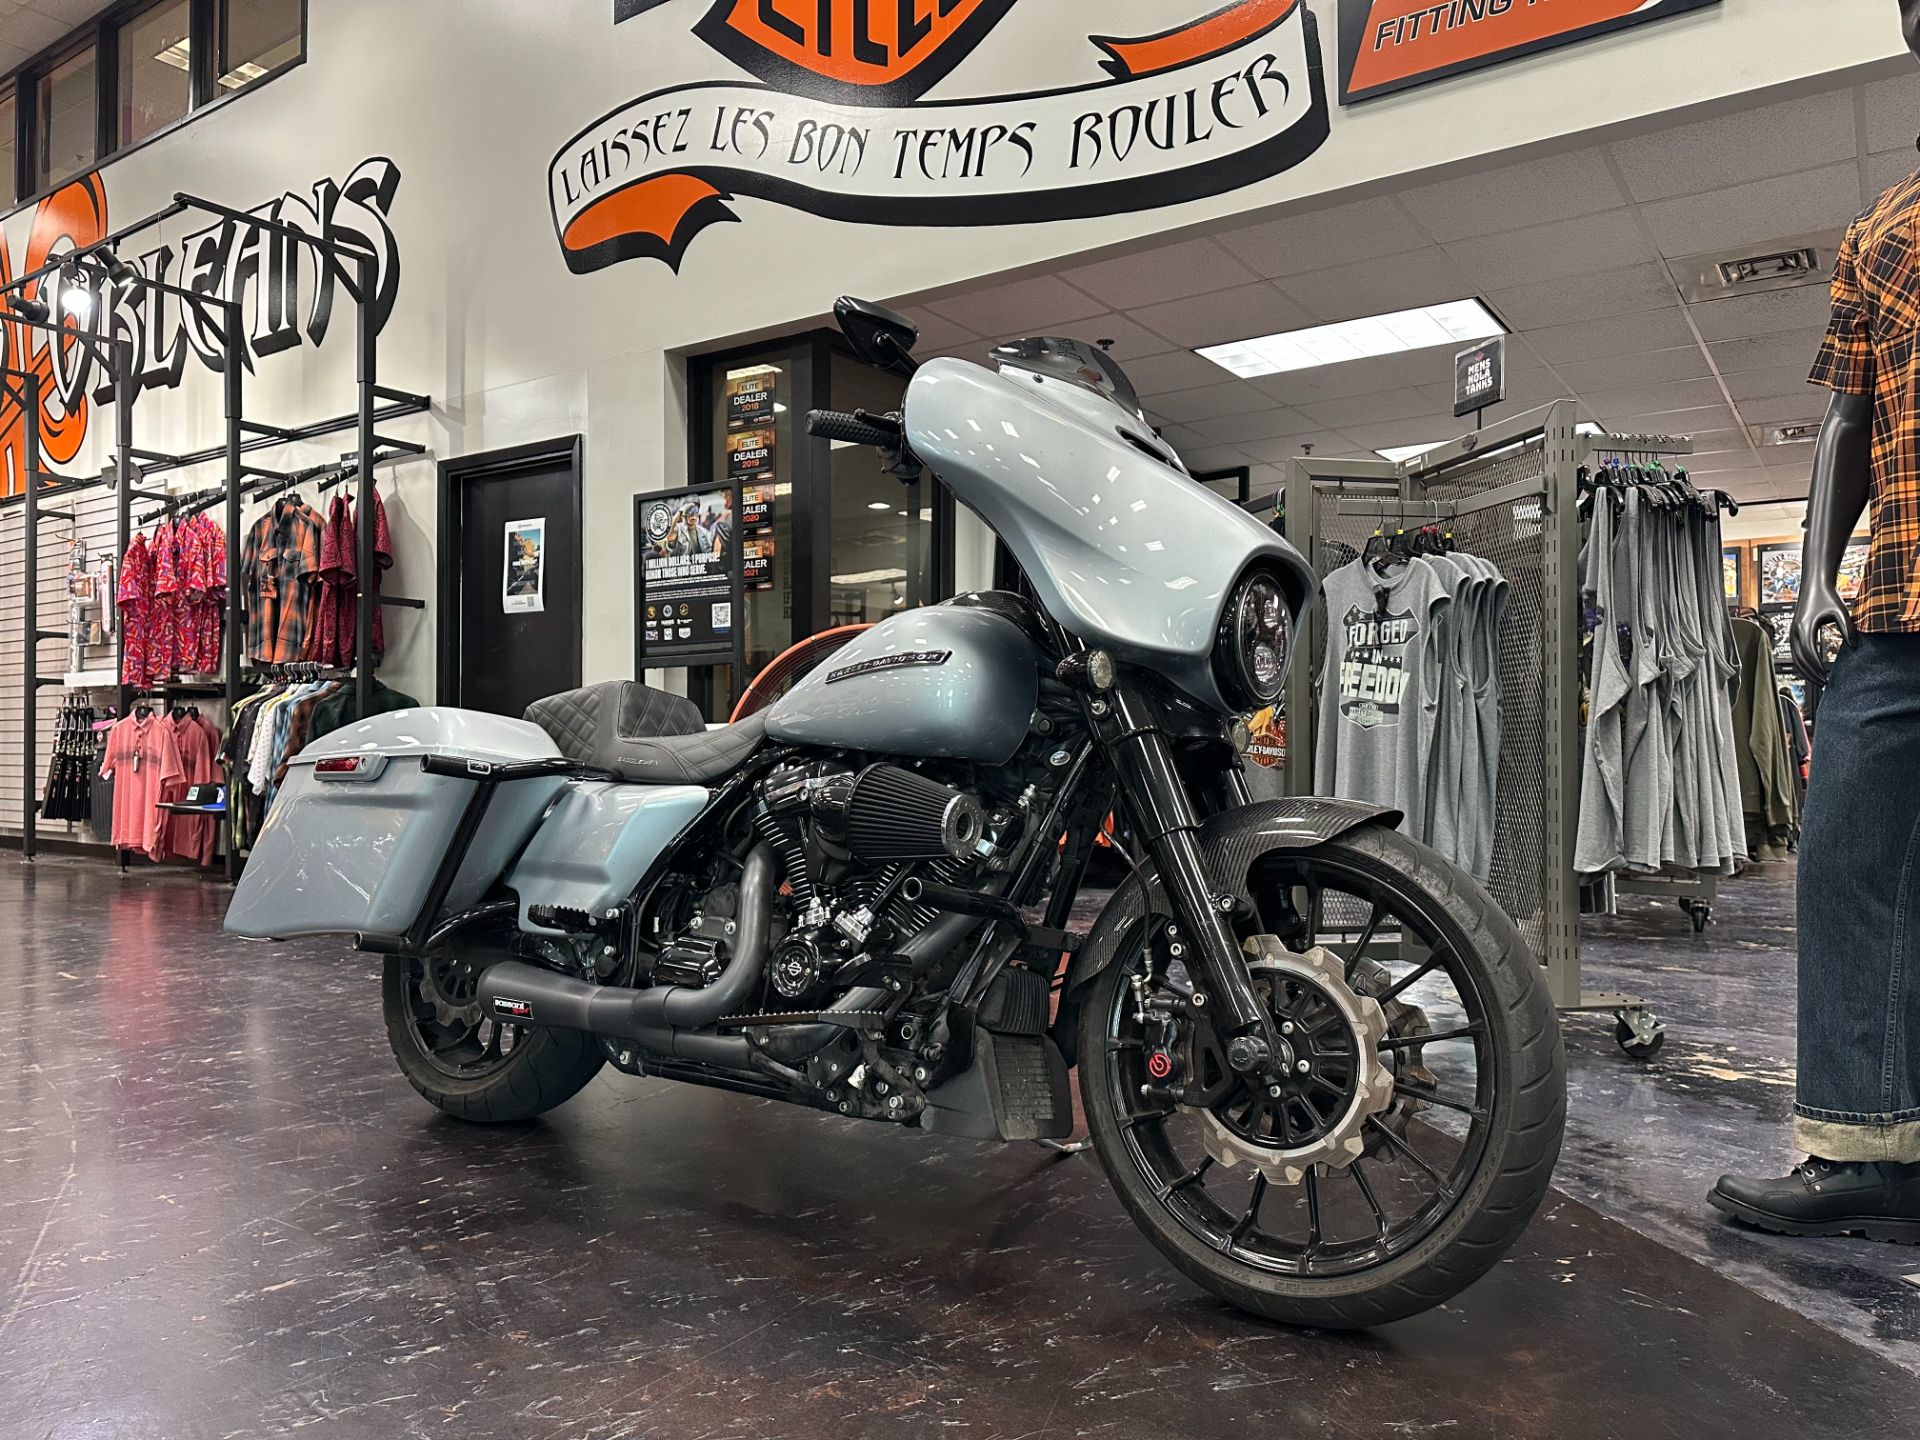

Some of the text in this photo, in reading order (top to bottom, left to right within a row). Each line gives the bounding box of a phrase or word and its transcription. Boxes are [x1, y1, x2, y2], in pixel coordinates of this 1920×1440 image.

[1373, 0, 1514, 51] FITTING
[560, 53, 1290, 208] LAISSEZ LES BON TEMPS ROULER
[1467, 358, 1491, 376] MENS
[1467, 368, 1491, 385] NOLA
[741, 383, 760, 392] ELITE
[1465, 376, 1493, 395] TANKS
[733, 392, 768, 405] DEALER
[741, 402, 760, 412] 2018
[741, 438, 760, 448] ELITE
[733, 449, 768, 462] DEALER
[741, 459, 760, 468] 2019
[743, 504, 768, 515] EALER
[1348, 619, 1409, 647] FORGED
[1371, 648, 1384, 664] IN
